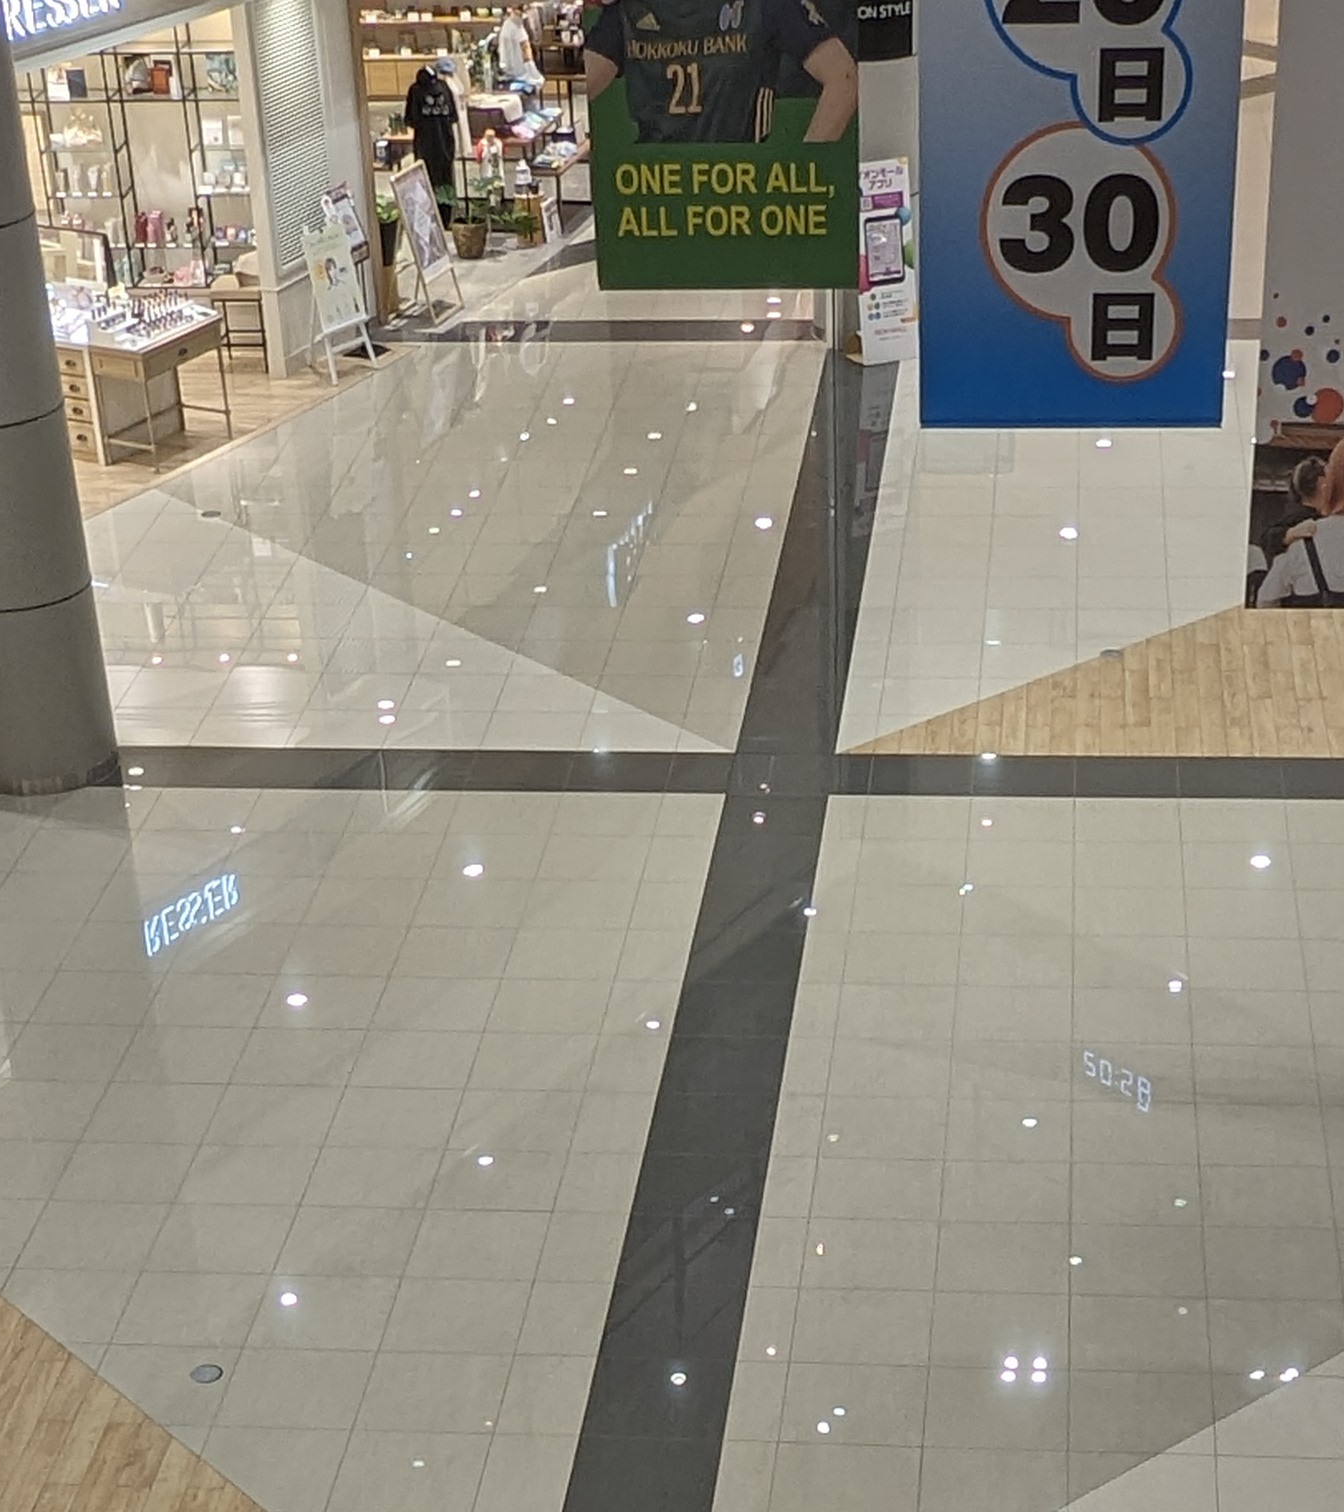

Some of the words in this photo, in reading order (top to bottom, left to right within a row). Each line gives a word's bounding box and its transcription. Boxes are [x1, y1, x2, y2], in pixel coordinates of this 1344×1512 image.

[879, 1, 912, 18] STYLE
[627, 38, 699, 59] HOKKOKU
[703, 34, 748, 57] BANK
[666, 62, 703, 115] 21
[1098, 47, 1165, 123] 日
[615, 163, 684, 196] ONE
[691, 162, 758, 195] FOR
[765, 161, 836, 199] ALL,
[858, 166, 904, 180] オンモール
[617, 206, 679, 238] ALL
[687, 205, 753, 237] FOR
[760, 204, 828, 237] ONE
[998, 173, 1160, 273] 30
[1091, 292, 1155, 362] 日
